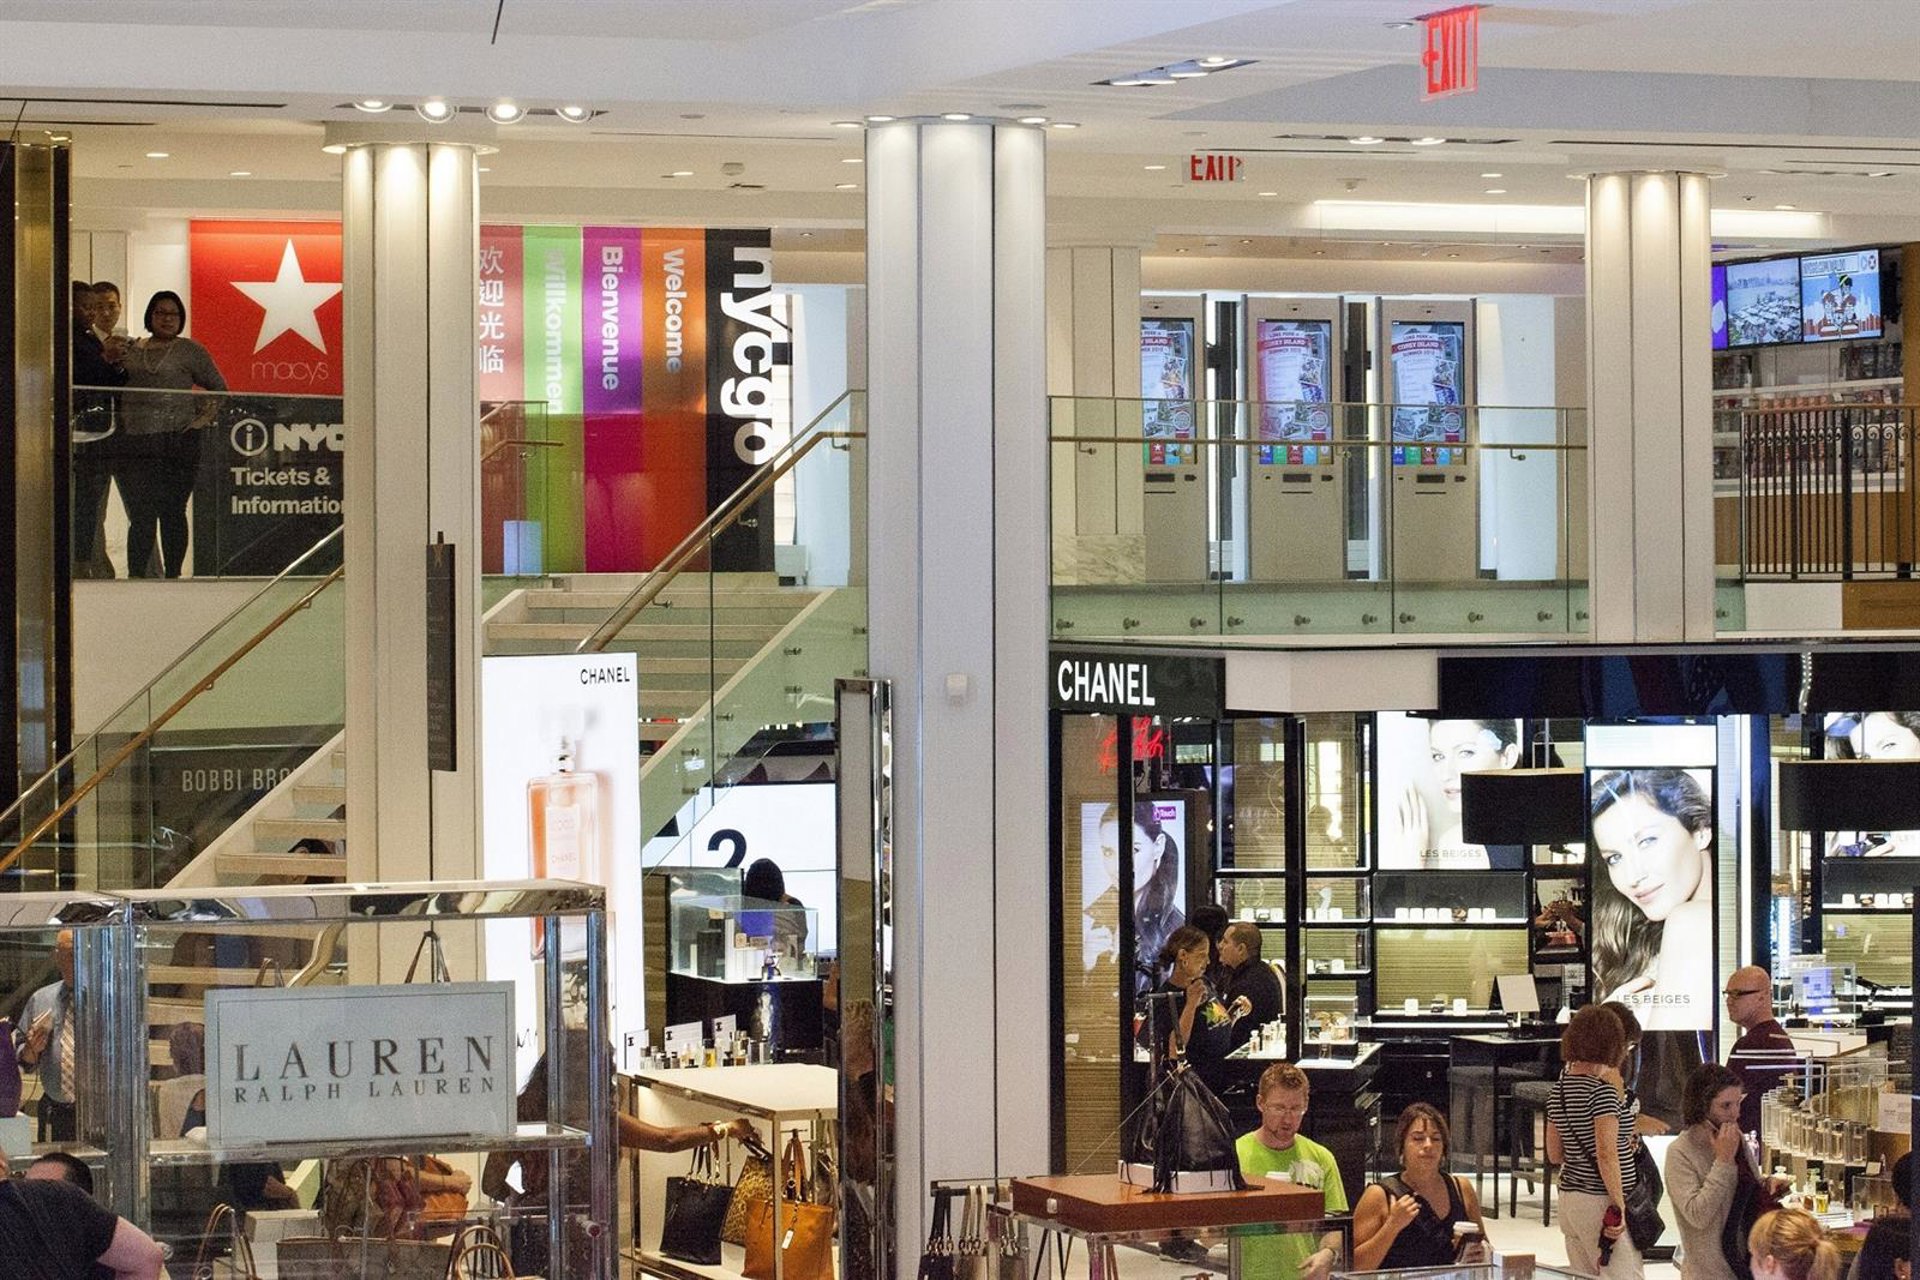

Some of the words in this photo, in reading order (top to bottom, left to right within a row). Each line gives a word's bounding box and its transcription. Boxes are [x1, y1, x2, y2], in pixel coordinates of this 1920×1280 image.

[1427, 11, 1468, 94] EXIT
[1190, 154, 1234, 181] EXIT
[602, 246, 623, 390] Bienvenue
[663, 248, 688, 374] Welcome
[545, 248, 567, 414] Willkommen
[720, 247, 773, 465] nycgo
[230, 467, 310, 486] Tickets
[314, 466, 331, 486] &
[231, 496, 344, 515] Informatio
[580, 667, 630, 685] CHANEL
[1057, 660, 1155, 706] CHANEL
[182, 769, 241, 792] BOBBI
[708, 829, 747, 868] 2
[1420, 849, 1439, 858] LES
[1442, 849, 1482, 858] BEIGES
[1644, 994, 1690, 1004] BEIGES
[235, 1036, 494, 1081] LAUREN
[235, 1084, 342, 1103] RALPH
[370, 1077, 494, 1097] LAUREN
